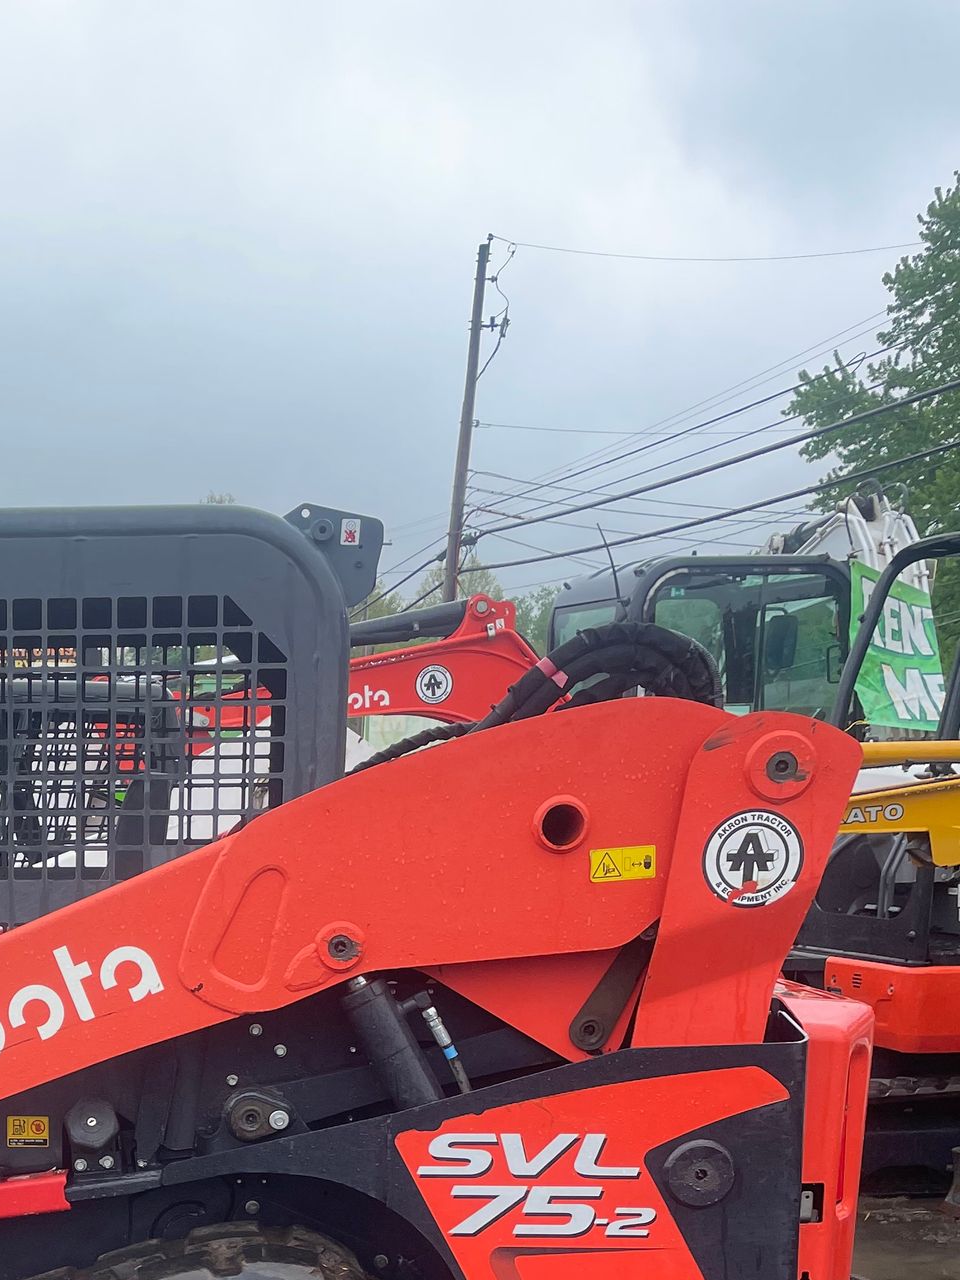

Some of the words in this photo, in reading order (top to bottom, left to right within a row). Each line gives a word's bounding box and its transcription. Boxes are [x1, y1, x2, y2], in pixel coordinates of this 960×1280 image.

[861, 576, 934, 655] EN
[348, 685, 390, 709] ota
[717, 815, 748, 840] AKRON
[751, 813, 792, 838] TRACTOR
[840, 803, 904, 825] ATO
[721, 887, 772, 903] EPMENT
[416, 1132, 642, 1180] SVL
[447, 1184, 658, 1239] 75-2
